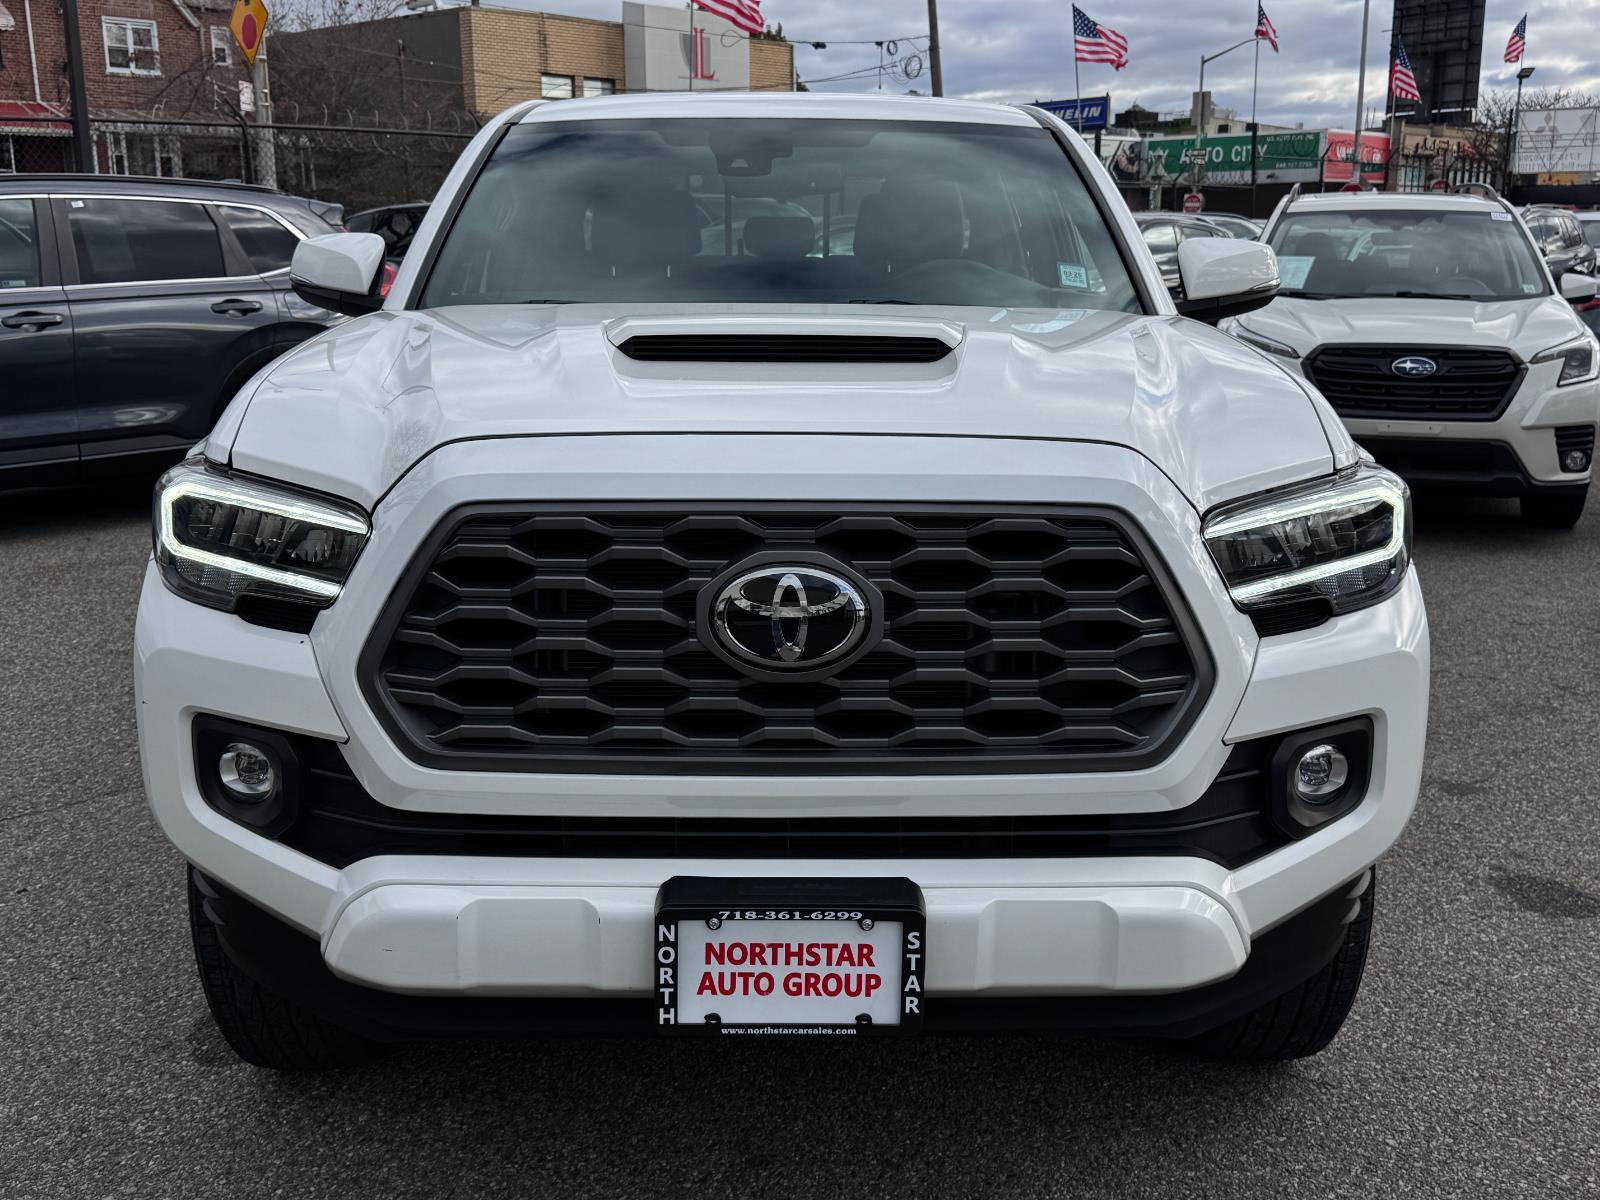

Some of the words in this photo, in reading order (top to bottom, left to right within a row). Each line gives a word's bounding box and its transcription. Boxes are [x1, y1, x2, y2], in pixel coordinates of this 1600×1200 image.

[1052, 105, 1102, 120] HELIN
[1179, 146, 1224, 165] ATO
[718, 910, 863, 921] 718-361-6299
[704, 942, 876, 968] NORTHSTAR
[657, 924, 676, 1025] NORTH
[903, 931, 921, 1014] STAR
[696, 971, 775, 996] AUTO
[782, 972, 882, 998] GROUP
[721, 1027, 857, 1035] www.northstarcarsales.com
